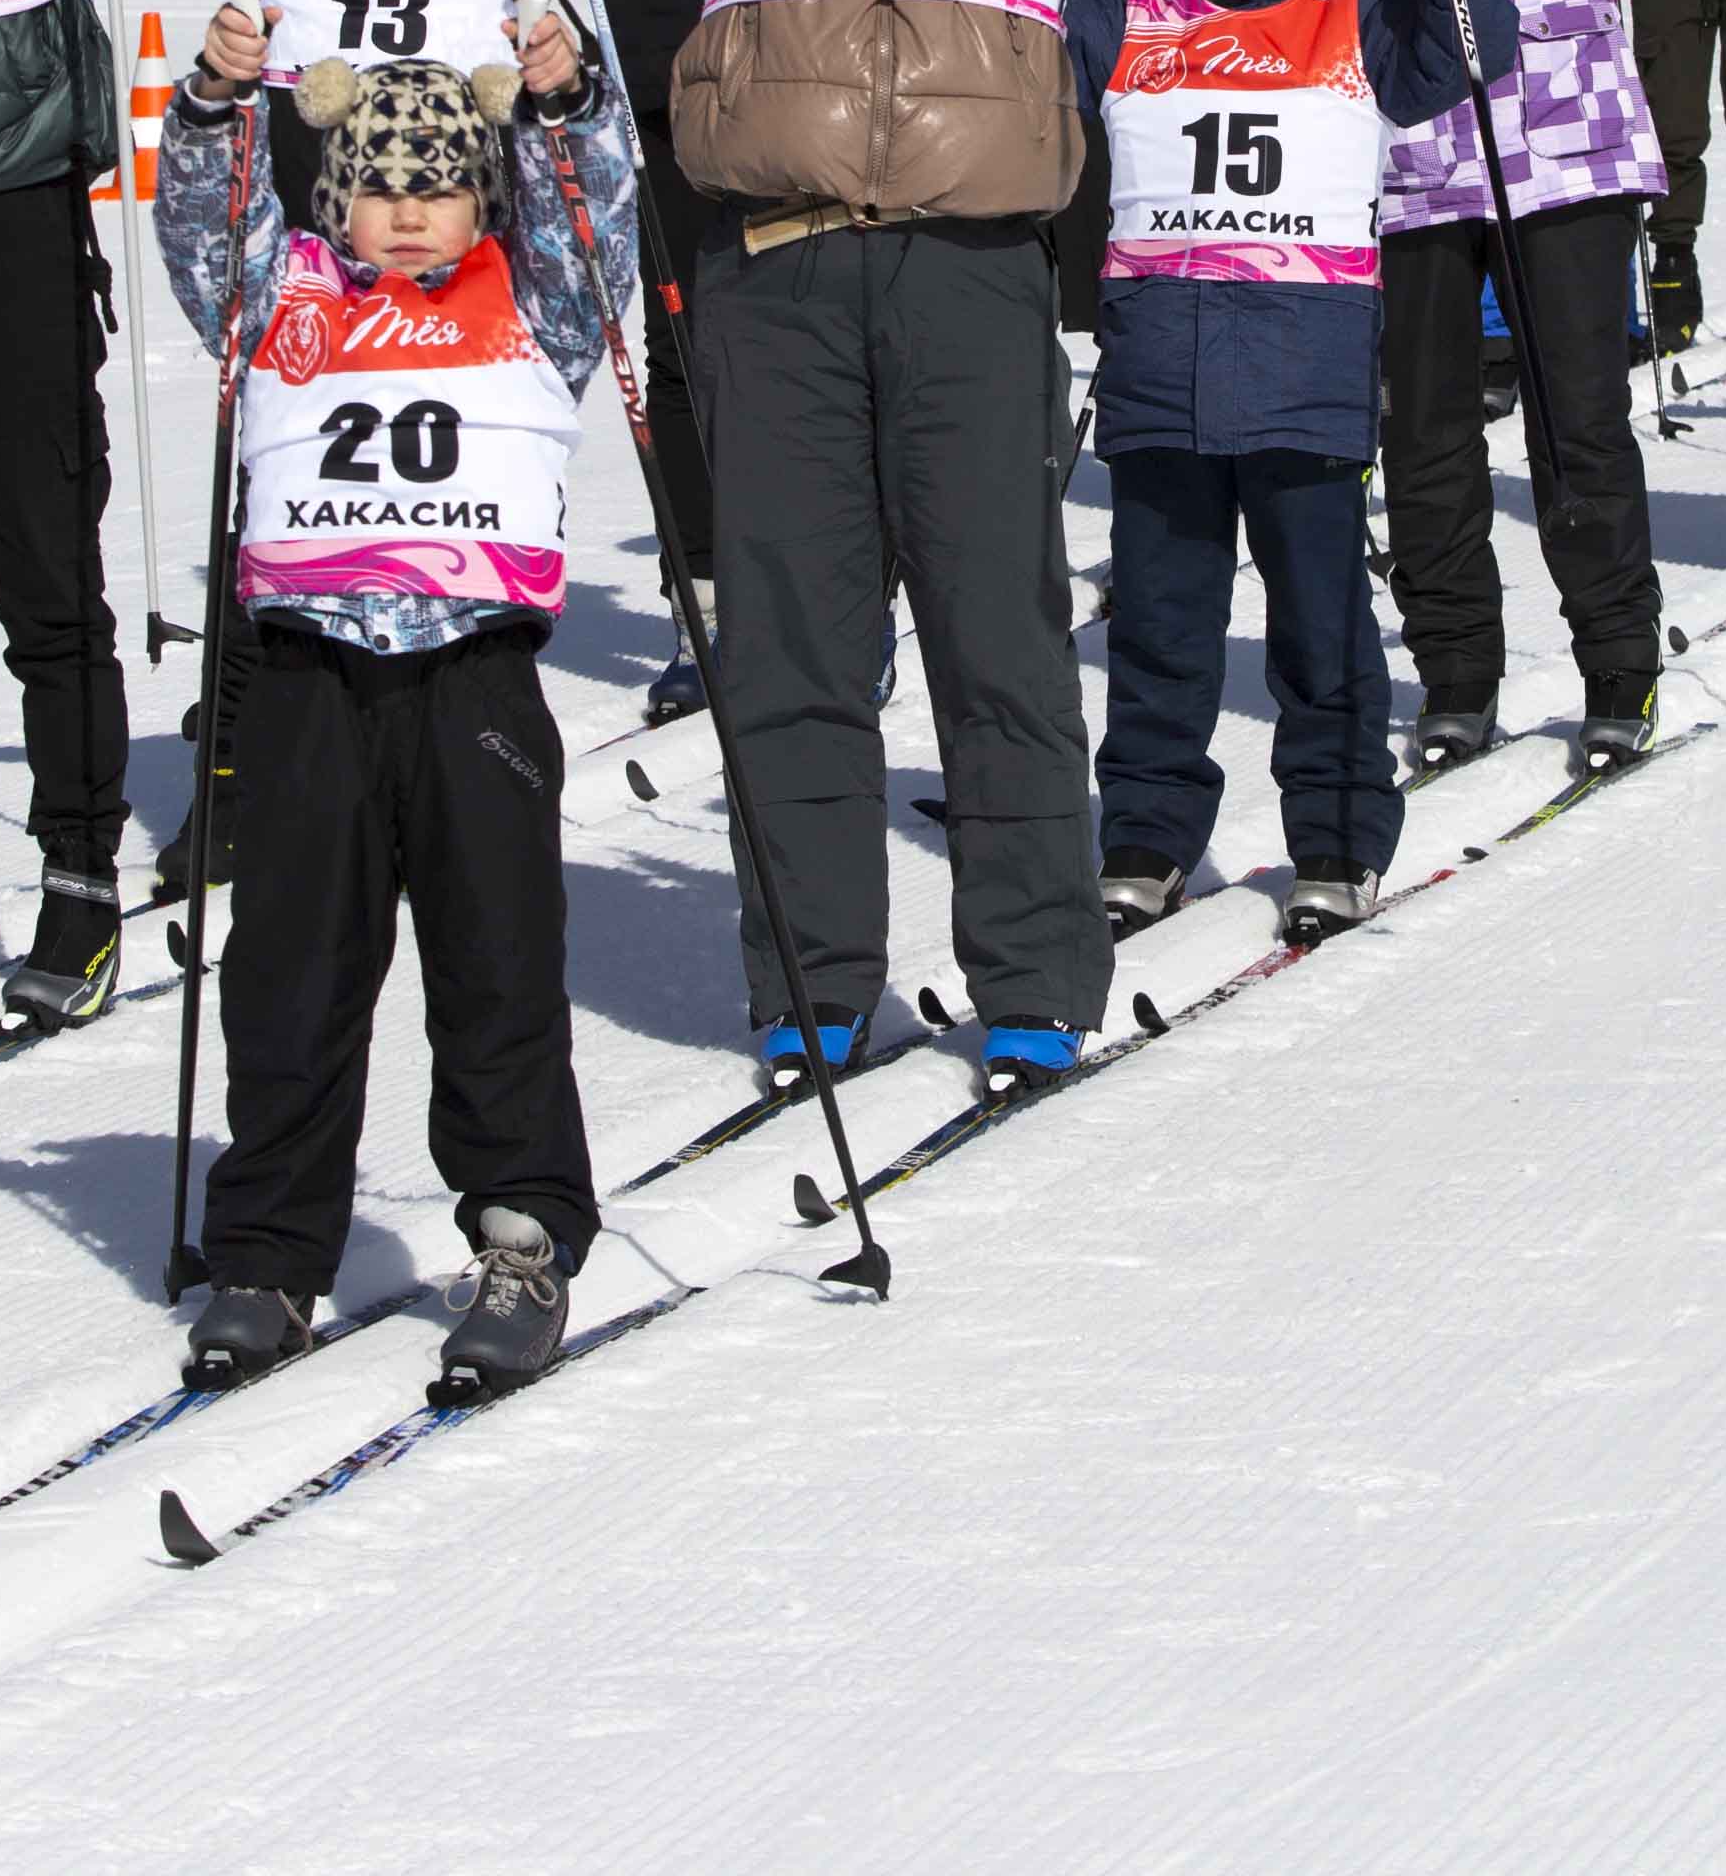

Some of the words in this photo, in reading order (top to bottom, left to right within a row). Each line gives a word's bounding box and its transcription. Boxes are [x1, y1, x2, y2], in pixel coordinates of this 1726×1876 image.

[1194, 35, 1293, 75] Тёя
[1182, 112, 1283, 197] 15
[1149, 209, 1314, 237] ХАКАСИЯ
[344, 293, 466, 353] Тёя
[318, 399, 462, 484] 20
[285, 500, 500, 531] ХАКАСИЯ
